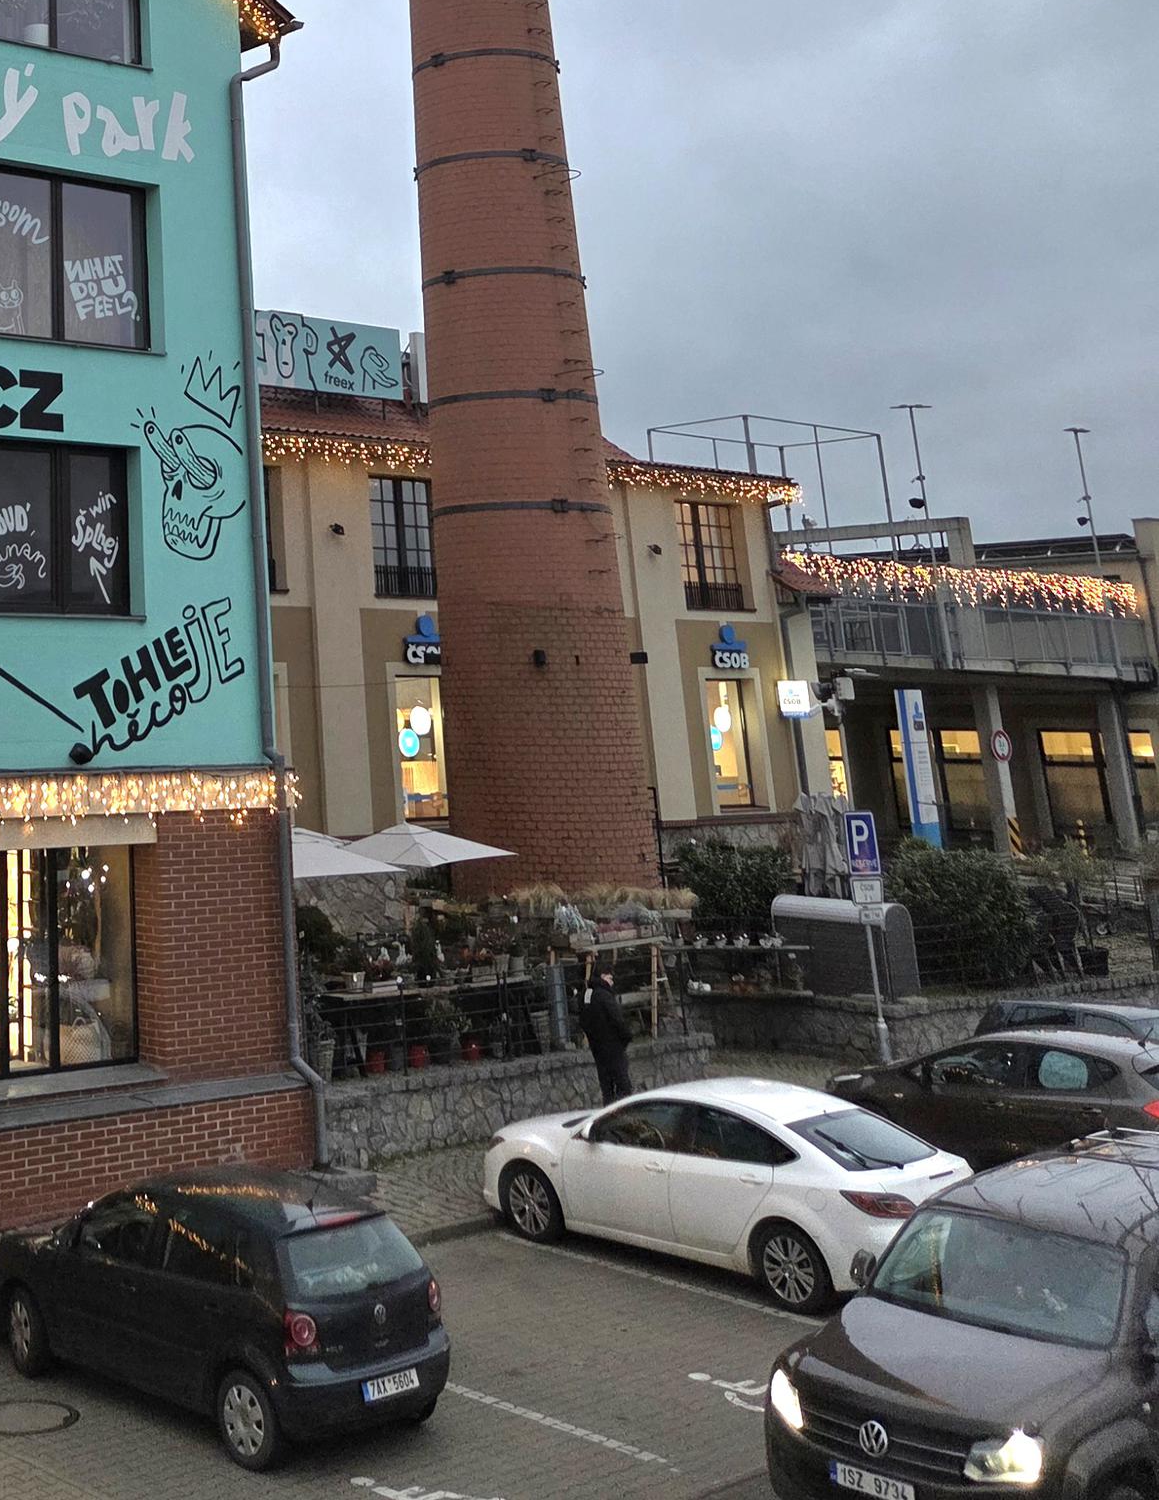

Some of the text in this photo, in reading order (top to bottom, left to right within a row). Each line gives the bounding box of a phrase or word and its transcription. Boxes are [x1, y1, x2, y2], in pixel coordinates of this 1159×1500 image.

[61, 90, 195, 163] park
[64, 255, 124, 282] WHAT
[69, 276, 127, 302] DO U
[324, 370, 355, 392] freex
[715, 650, 750, 669] ČSOB
[850, 819, 869, 856] P
